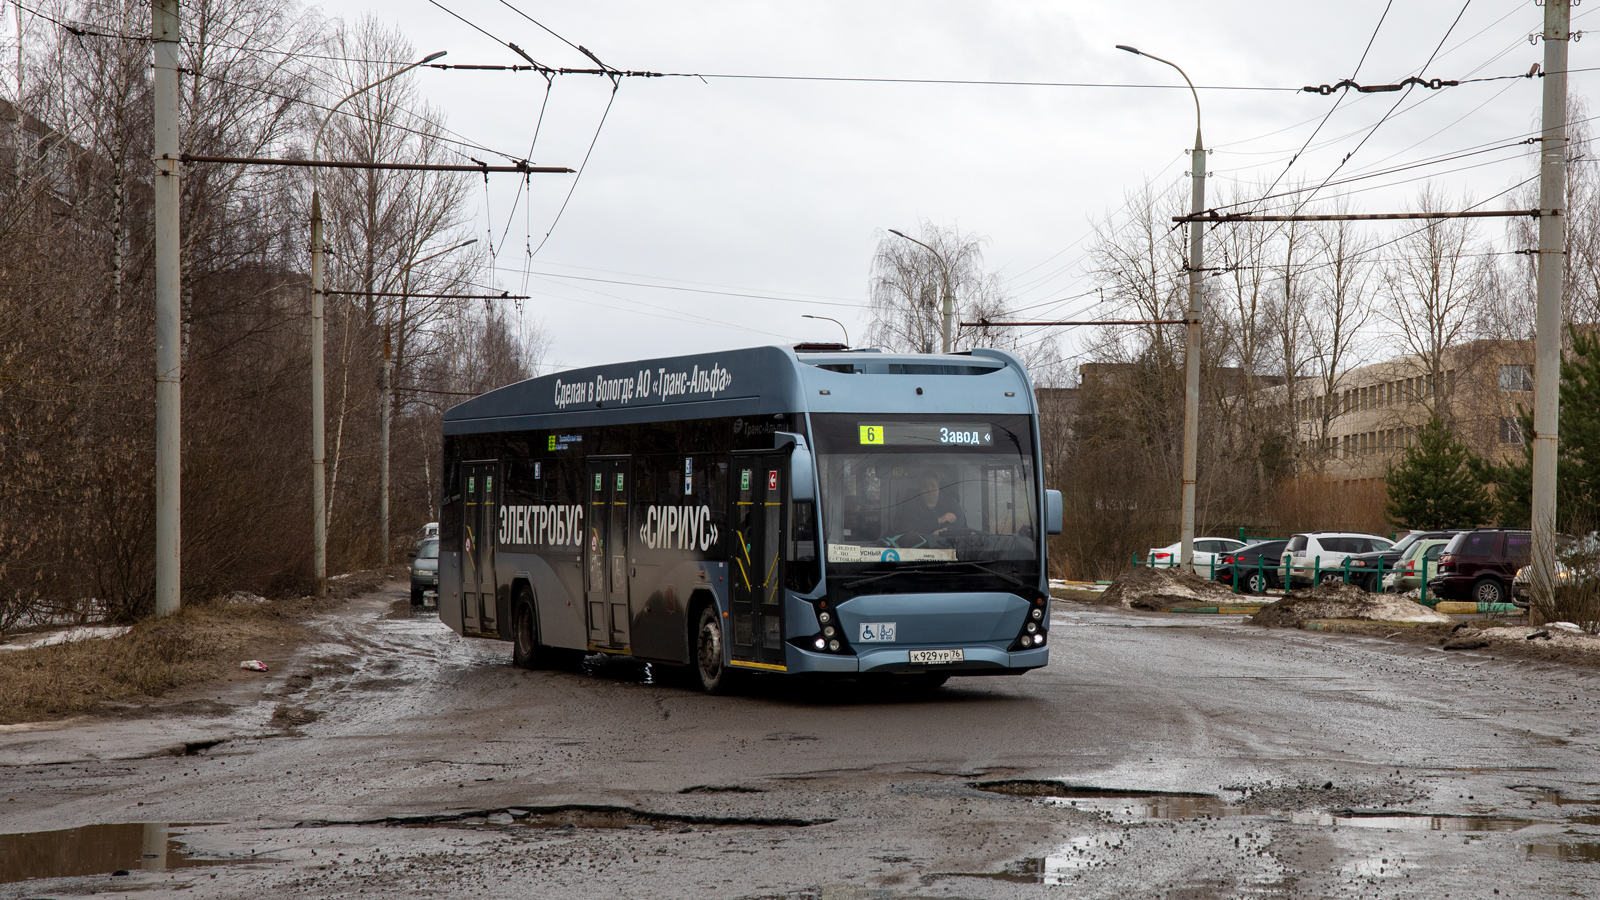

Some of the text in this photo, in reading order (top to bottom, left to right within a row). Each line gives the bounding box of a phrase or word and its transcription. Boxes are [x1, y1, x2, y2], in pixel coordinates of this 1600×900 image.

[554, 362, 732, 409] Сделан в Вологде АО «Транс-Альфа»
[867, 427, 875, 442] 6
[939, 427, 980, 445] Завод
[499, 504, 583, 547] ЭЛЕКТРОБУС
[639, 504, 719, 551] «СИРИУС»
[885, 551, 895, 561] 6
